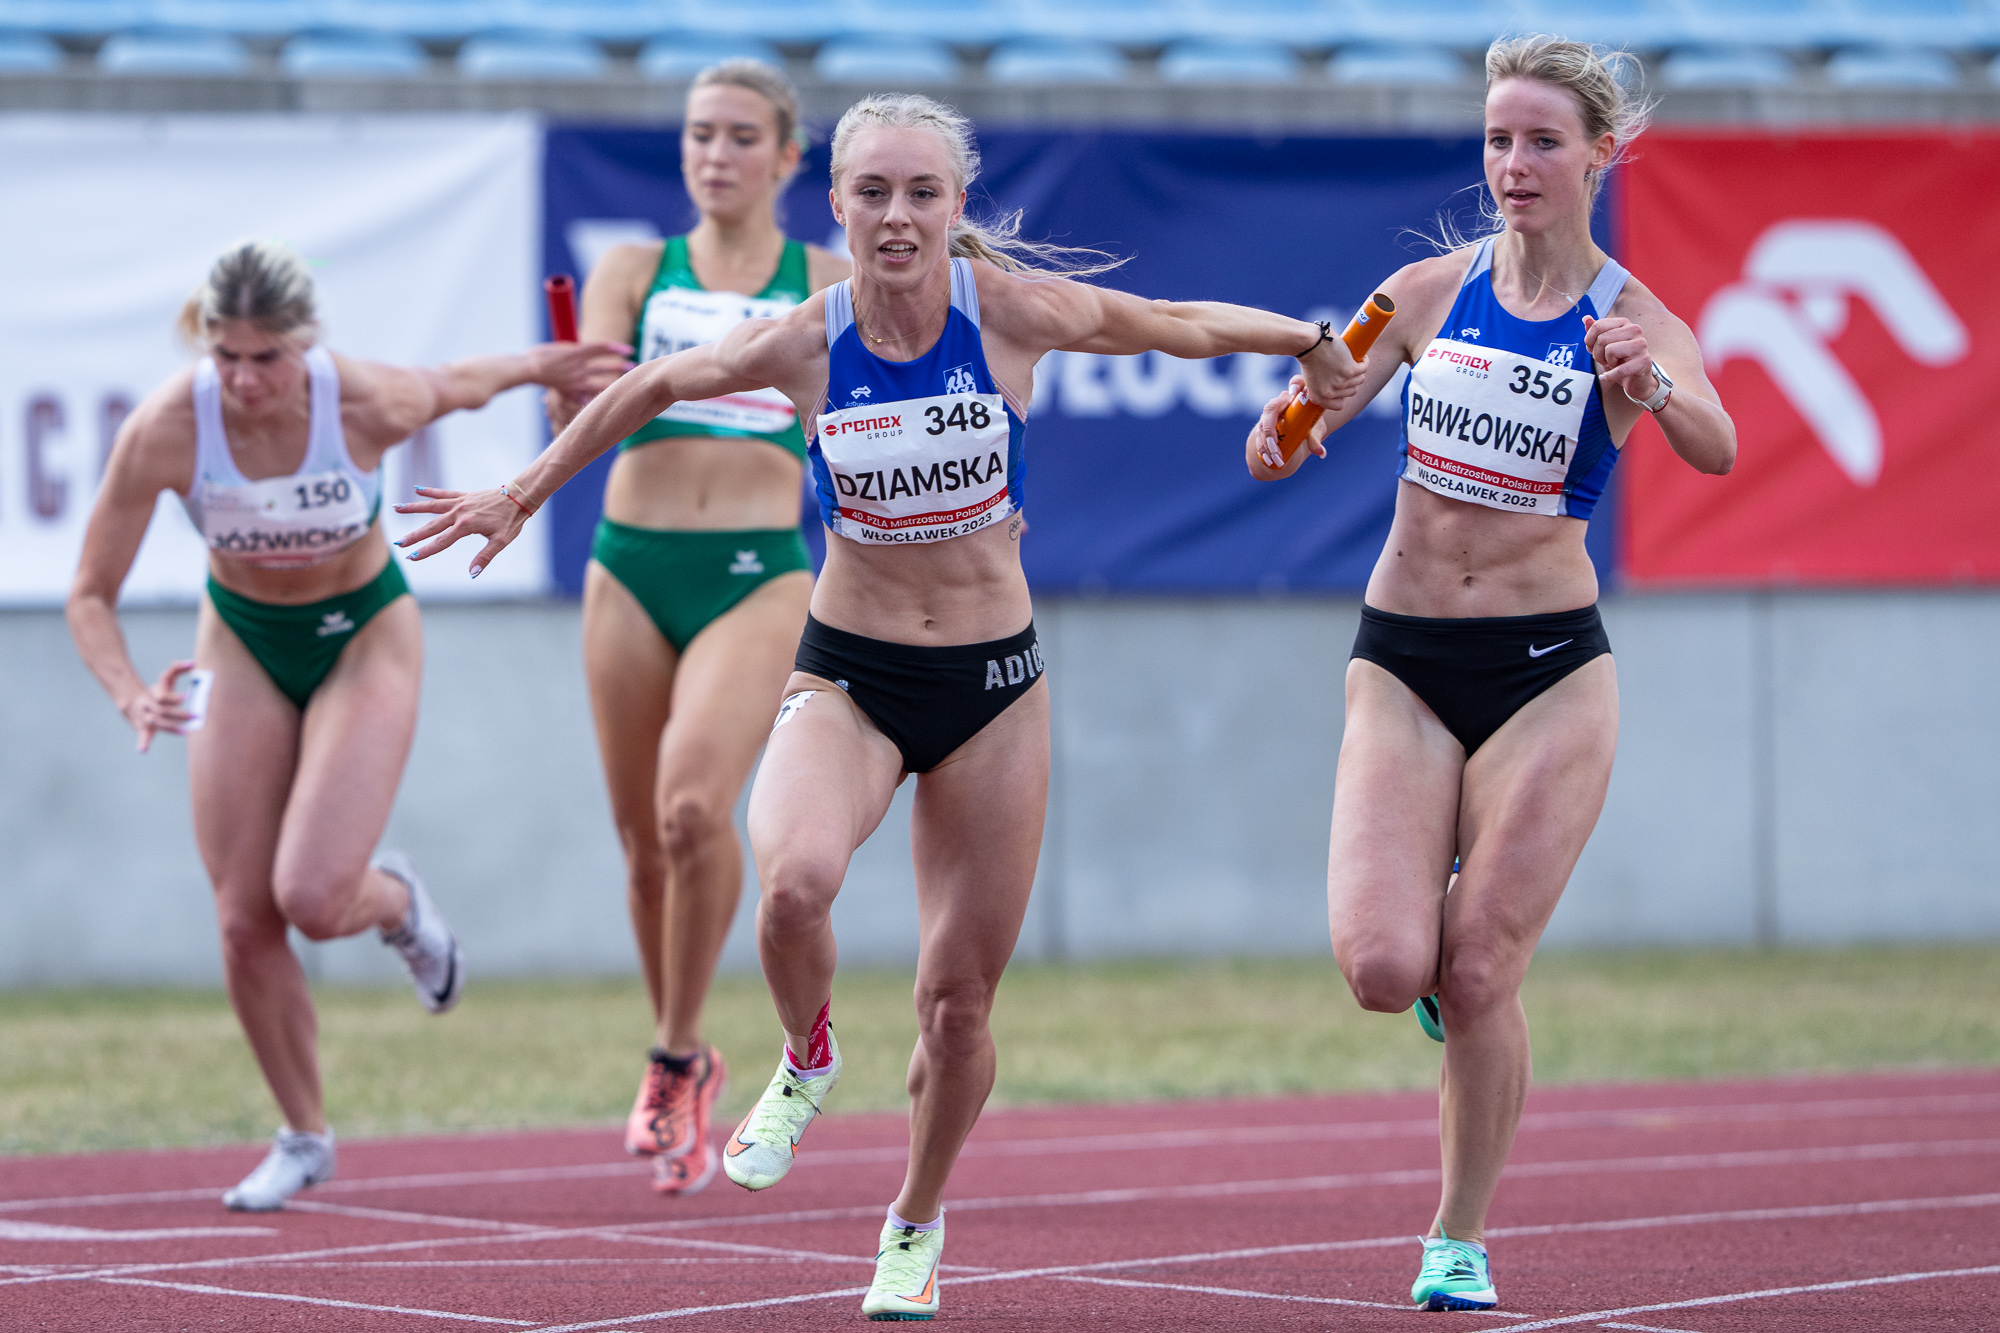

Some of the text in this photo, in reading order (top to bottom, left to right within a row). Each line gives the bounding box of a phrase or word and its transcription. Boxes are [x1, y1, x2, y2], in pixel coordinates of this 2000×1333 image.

[1439, 350, 1493, 372] renex
[1455, 366, 1489, 380] GROUP
[1508, 365, 1574, 406] 356
[841, 415, 902, 435] renex
[867, 430, 904, 440] GROUP
[924, 401, 991, 436] 348
[1410, 392, 1567, 466] PAWŁOWSKA
[834, 451, 1004, 502] DZIAMSKA
[1417, 466, 1538, 508] WŁOCŁAWEK 2023
[1421, 454, 1440, 468] PZLA
[1440, 461, 1500, 485] Mistrzostwa
[1501, 477, 1532, 491] Polski
[1533, 484, 1552, 493] U23
[294, 478, 351, 510] 150
[851, 494, 1001, 528] 40. PZLA Mistrzostwa Polski U23
[861, 512, 992, 542] WŁOCŁAWEK 2023
